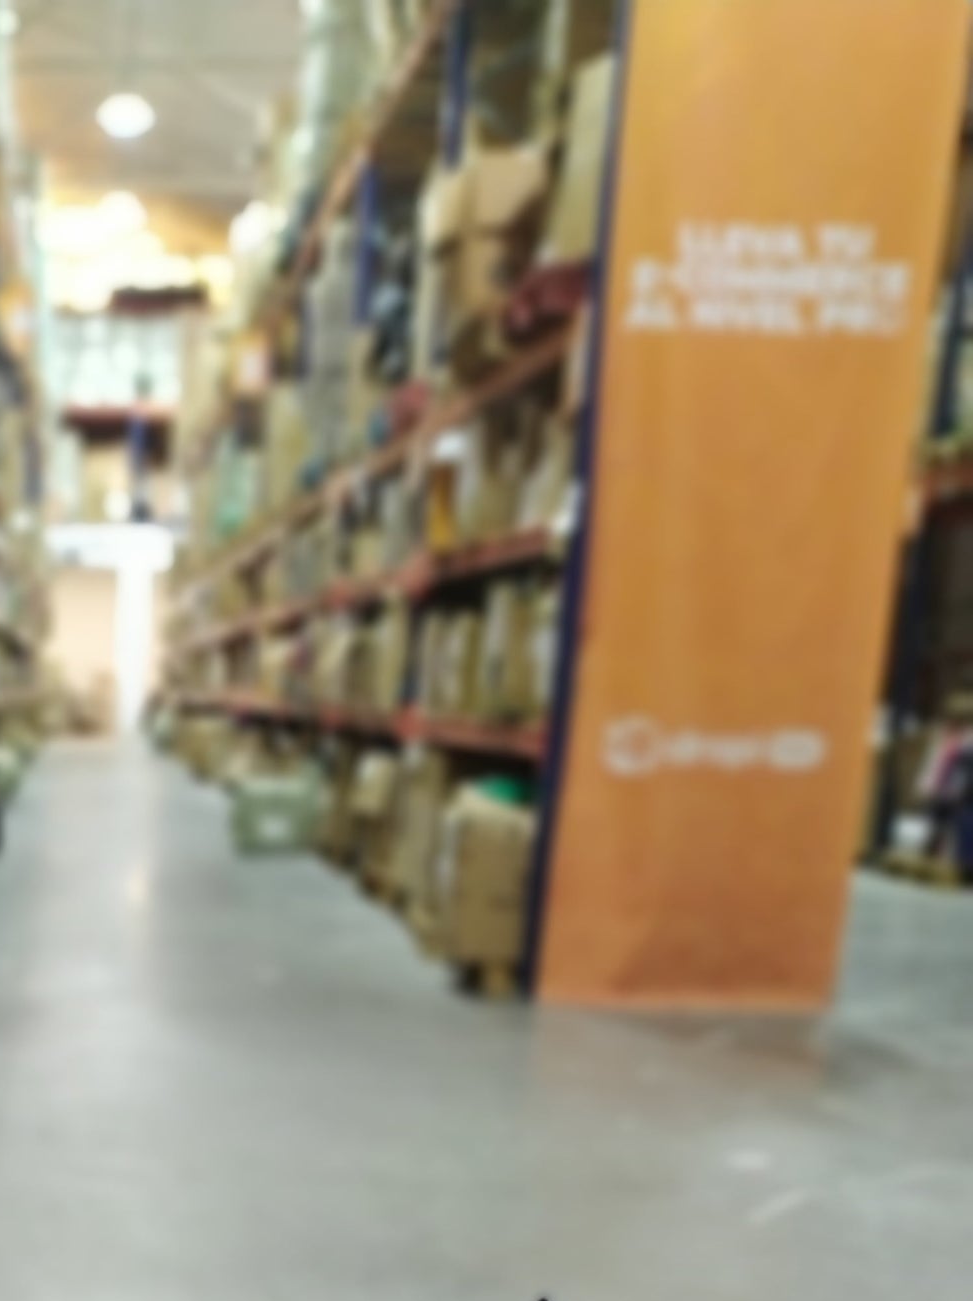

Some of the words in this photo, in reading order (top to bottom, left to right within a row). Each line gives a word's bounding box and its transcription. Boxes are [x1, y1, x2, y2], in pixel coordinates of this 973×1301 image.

[676, 222, 804, 260] LLEVA
[817, 224, 878, 260] TU
[632, 261, 911, 298] E-COMMERCE
